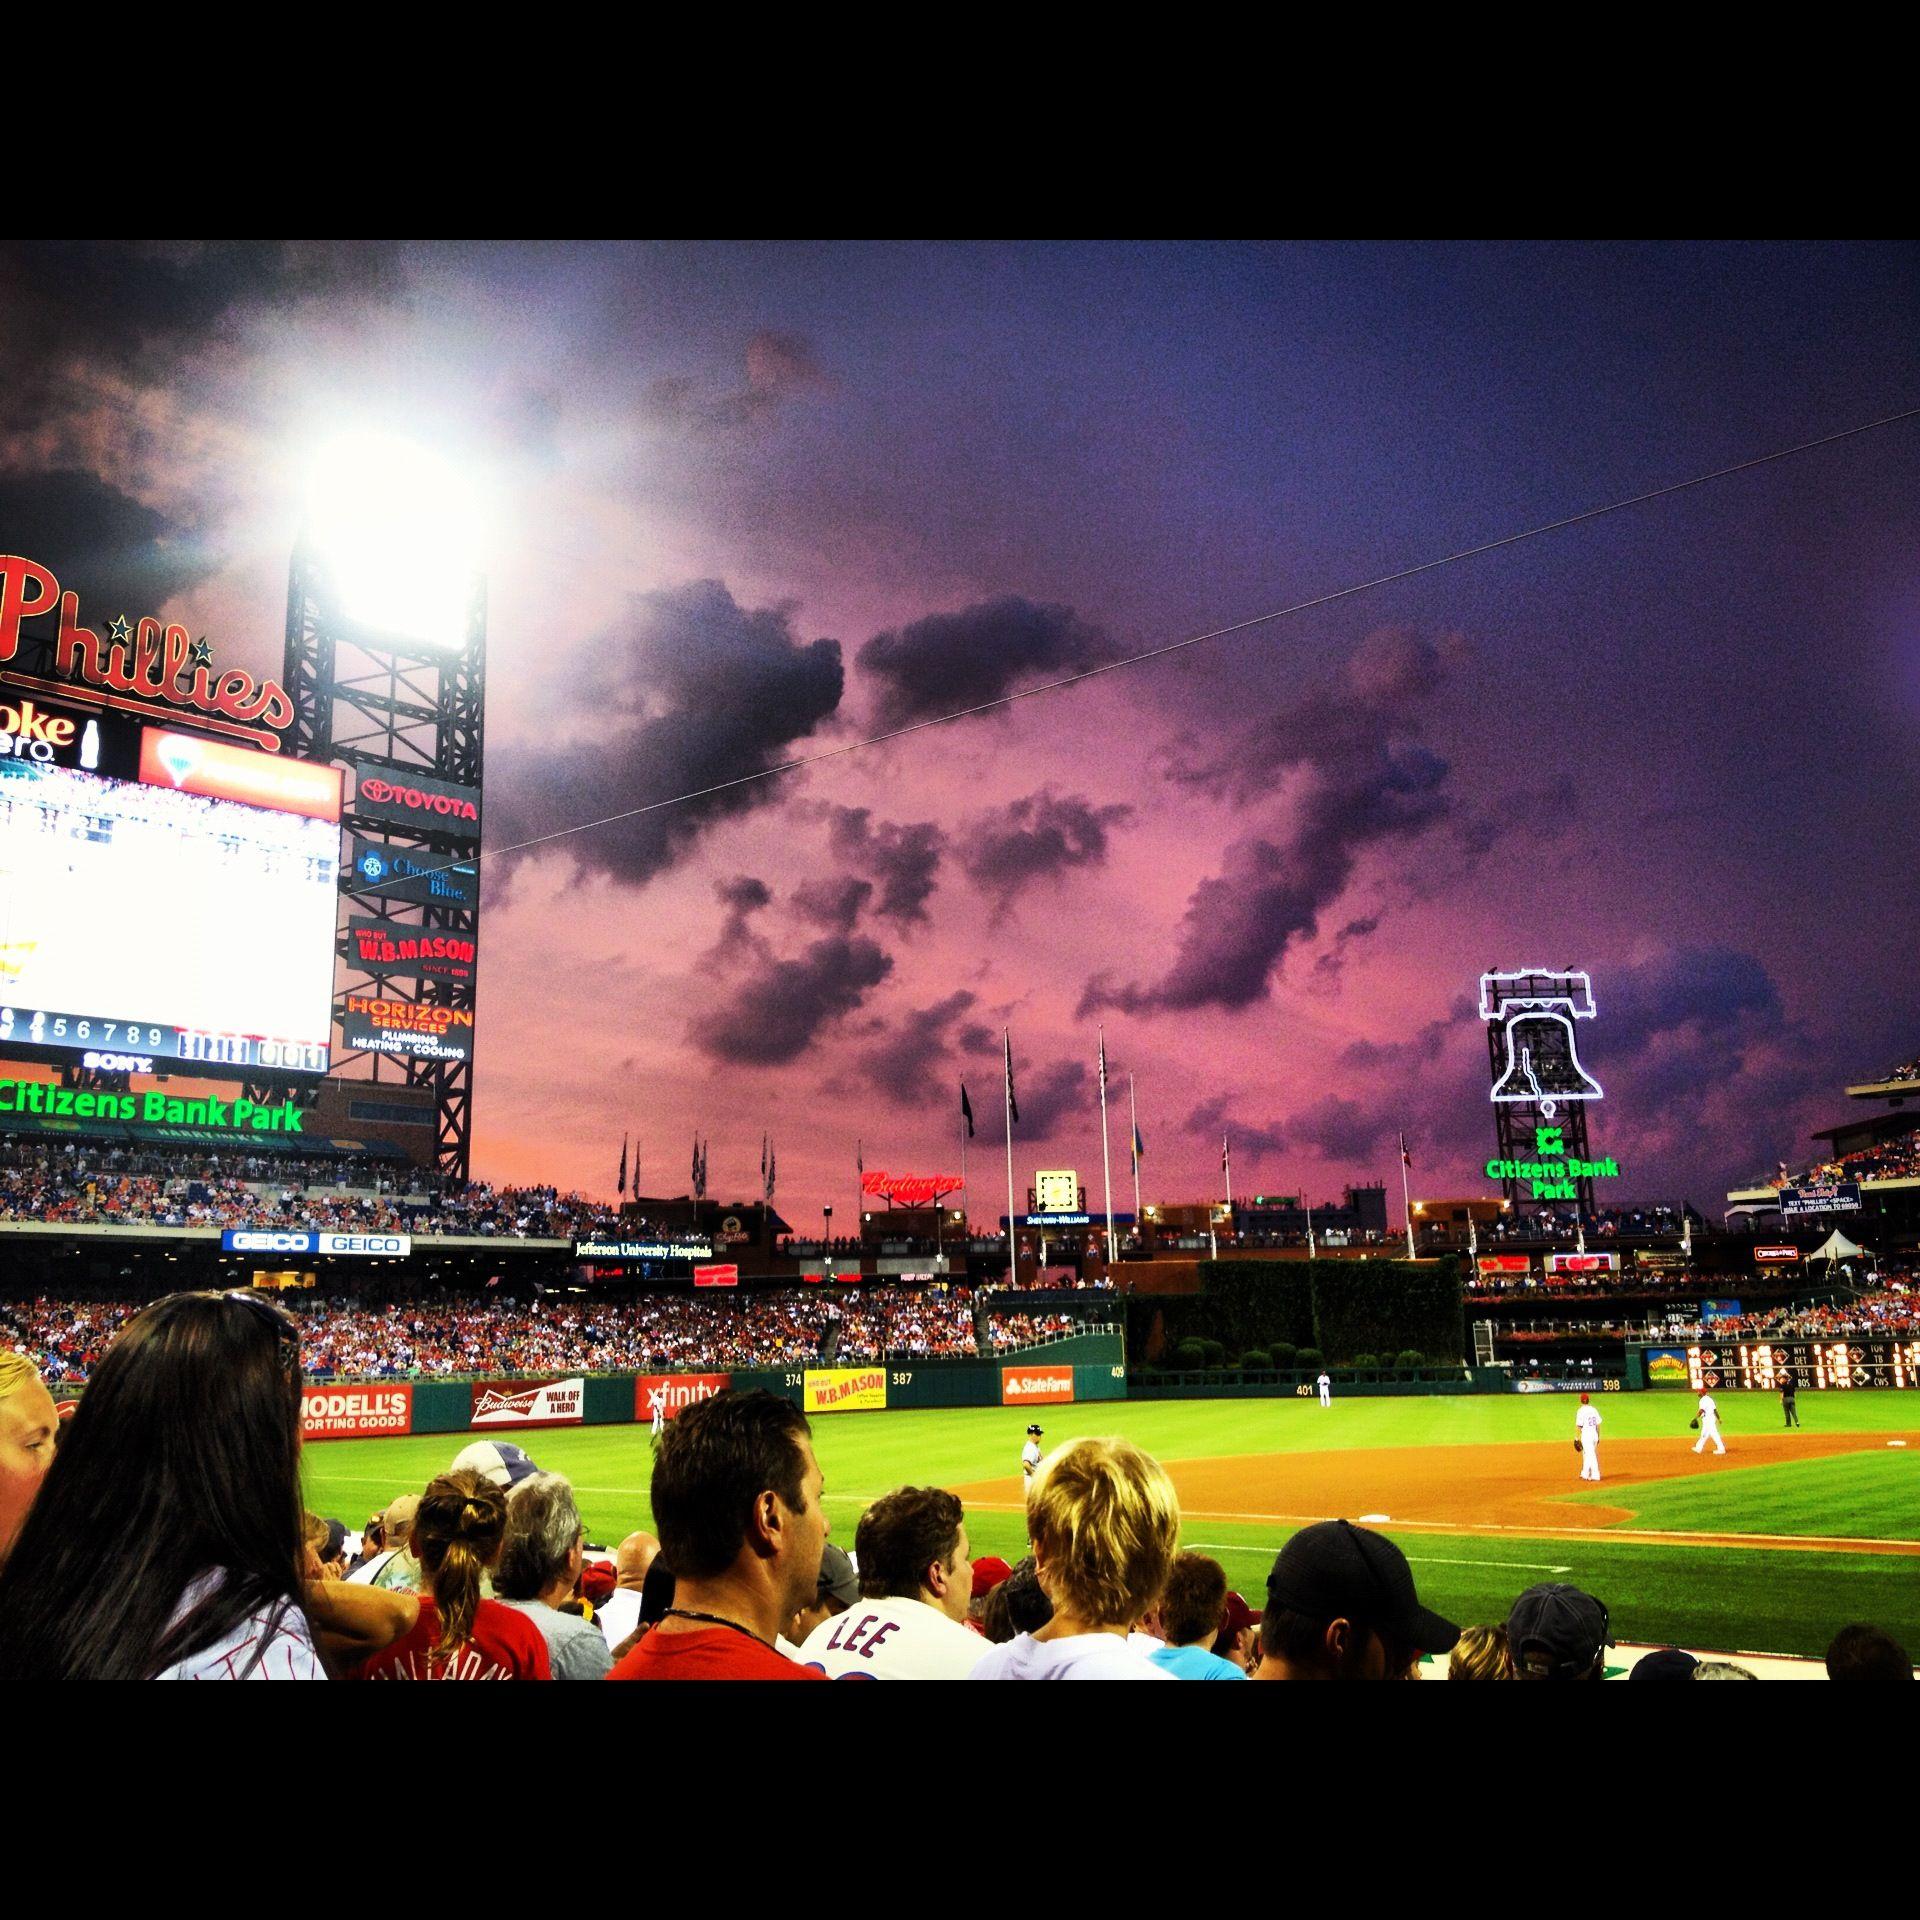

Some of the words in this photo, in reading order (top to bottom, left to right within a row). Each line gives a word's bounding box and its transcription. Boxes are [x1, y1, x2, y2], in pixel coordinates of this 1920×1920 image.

[0, 555, 295, 729] Phillies
[0, 700, 75, 746] oke
[391, 785, 478, 821] TOYOTA
[393, 859, 449, 881] Choose
[373, 930, 387, 940] BUT
[347, 996, 473, 1027] HORIZON
[54, 1018, 67, 1037] 5
[77, 1020, 91, 1040] 6
[103, 1023, 117, 1042] 7
[127, 1025, 140, 1044] 8
[149, 1028, 162, 1047] 9
[371, 1016, 447, 1034] SERVICES
[381, 1030, 438, 1046] PLUMBING
[352, 1037, 403, 1052] HEATING
[412, 1043, 465, 1059] COOLING
[0, 1079, 136, 1120] Citizens
[144, 1091, 228, 1127] Bank
[233, 1097, 304, 1132] Park
[1486, 1159, 1566, 1179] Citizens
[1568, 1157, 1619, 1178] Bank
[1532, 1179, 1577, 1199] Park
[232, 1232, 310, 1251] GEICO
[332, 1236, 400, 1251] GEICO
[576, 1241, 619, 1257] Jefferson
[620, 1242, 669, 1260] University
[670, 1244, 713, 1261] Hospitals
[1795, 1357, 1807, 1366] DET
[785, 1374, 802, 1387] 374
[892, 1373, 912, 1385] 387
[1724, 1369, 1736, 1378] MIN
[1874, 1378, 1889, 1386] CWS
[1297, 1384, 1313, 1396] 401
[1602, 1379, 1620, 1391] 398
[1726, 1379, 1736, 1388] CLE
[1798, 1378, 1810, 1387] BOS
[546, 1390, 580, 1402] WALK-OFF
[646, 1380, 720, 1408] xfinity
[475, 1396, 535, 1411] Budweise
[550, 1403, 556, 1413] A
[557, 1402, 575, 1413] HERO
[304, 1417, 356, 1431] ORTING
[359, 1415, 406, 1429] GOODS
[827, 1615, 900, 1659] LEE
